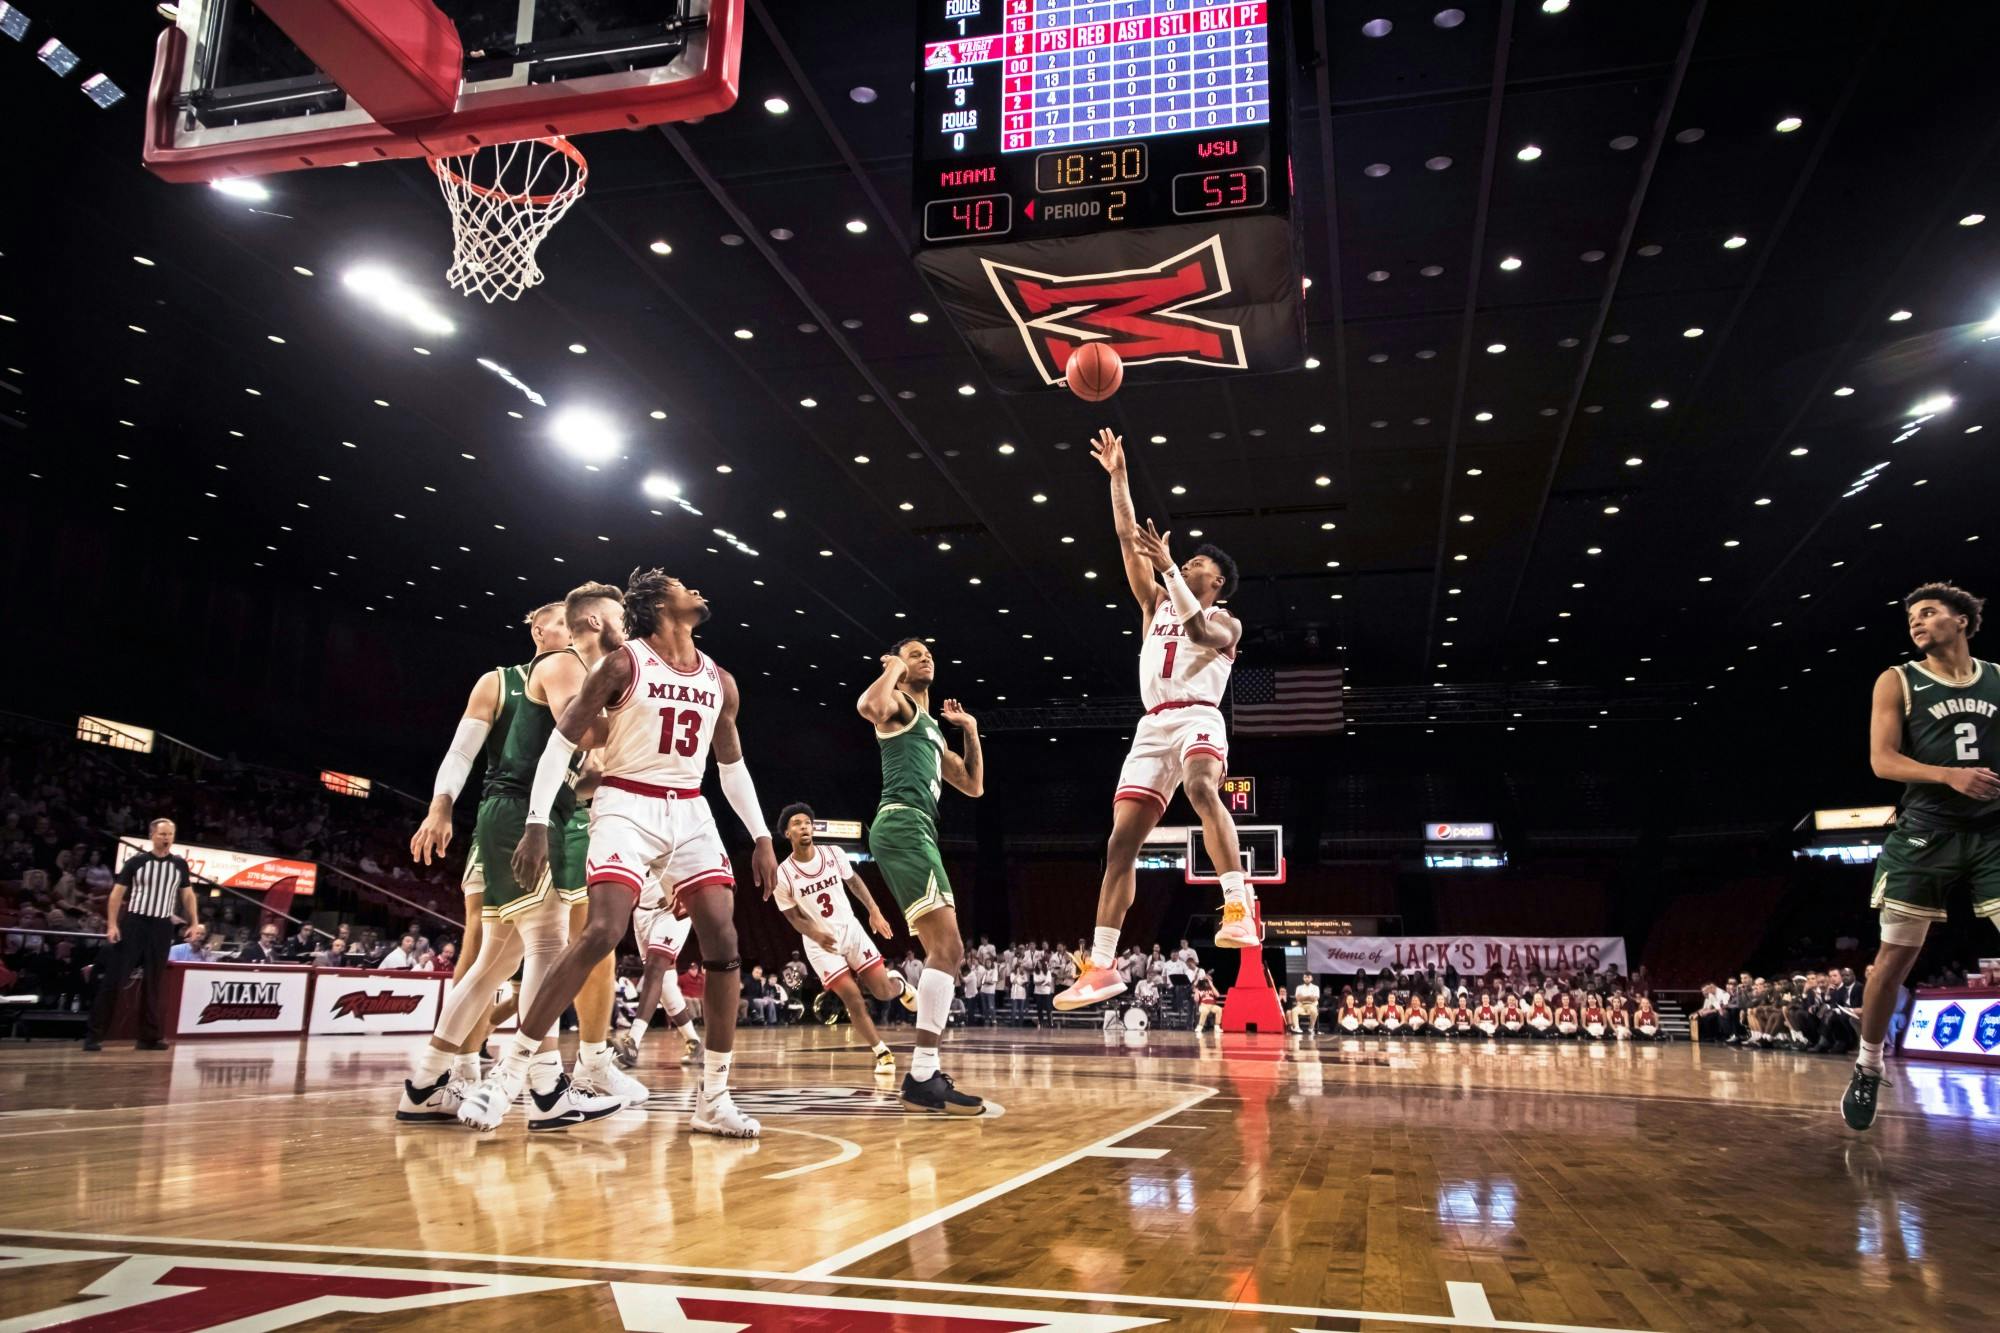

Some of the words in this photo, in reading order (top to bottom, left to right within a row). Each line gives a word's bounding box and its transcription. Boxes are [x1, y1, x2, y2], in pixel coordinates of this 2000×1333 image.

[946, 0, 980, 15] FOULS
[1011, 0, 1027, 13] 14
[1011, 19, 1026, 32] 15
[1088, 9, 1095, 22] 1
[1127, 4, 1134, 17] 1
[958, 19, 966, 35] 1
[1014, 36, 1024, 54] #
[1040, 32, 1067, 51] PTS
[1077, 26, 1105, 47] REB
[1118, 20, 1145, 41] AST
[1160, 15, 1187, 35] STL
[1200, 8, 1229, 31] BLK
[1241, 5, 1259, 25] PF
[1010, 60, 1028, 73] 00
[1048, 56, 1056, 69] 2
[1087, 50, 1096, 63] 0
[1128, 45, 1135, 58] 1
[1168, 40, 1176, 53] 0
[1207, 35, 1215, 48] 0
[1245, 30, 1253, 43] 2
[947, 67, 974, 85] T.O.L
[1014, 79, 1021, 92] 1
[1087, 69, 1096, 82] 5
[1128, 63, 1136, 77] 0
[1168, 58, 1176, 72] 0
[1208, 53, 1215, 66] 1
[1246, 49, 1253, 62] 1
[954, 89, 966, 105] 3
[1013, 96, 1021, 109] 2
[1047, 91, 1056, 105] 4
[1088, 87, 1095, 100] 1
[1128, 82, 1136, 95] 0
[1168, 77, 1176, 90] 0
[1208, 72, 1216, 85] 0
[1245, 68, 1253, 81] 2
[942, 110, 977, 129] FOULS
[1011, 115, 1024, 128] 11
[1046, 111, 1059, 125] 17
[1087, 107, 1096, 120] 5
[1128, 102, 1135, 115] 1
[1168, 97, 1175, 110] 1
[1208, 92, 1216, 105] 0
[1246, 88, 1253, 101] 1
[1047, 130, 1055, 143] 2
[1088, 126, 1095, 139] 1
[1128, 121, 1136, 134] 2
[1168, 116, 1176, 129] 0
[1208, 112, 1217, 124] 0
[1247, 107, 1255, 120] 0
[954, 133, 965, 150] 0
[1198, 139, 1239, 158] WSU
[941, 166, 996, 187] MIAMI
[1056, 147, 1140, 184] 18:30
[1203, 172, 1247, 206] 53
[953, 200, 993, 230] 40
[1044, 201, 1100, 220] PERIOD
[1108, 191, 1126, 221] 2
[1152, 624, 1188, 637] MIA
[1162, 641, 1177, 678] 1
[648, 682, 716, 709] MIAMI
[1928, 698, 1998, 720] WRIGHT
[658, 707, 702, 757] 13
[1954, 722, 1979, 760] 2
[1224, 781, 1251, 792] 18:30
[1232, 792, 1247, 810] 19
[1453, 826, 1485, 838] pepsi
[800, 875, 838, 898] MIAMI
[816, 892, 834, 918] 3
[1327, 948, 1366, 960] Home
[1368, 949, 1384, 964] of
[1484, 943, 1601, 970] MANIACS
[210, 981, 282, 1005] MIAMI
